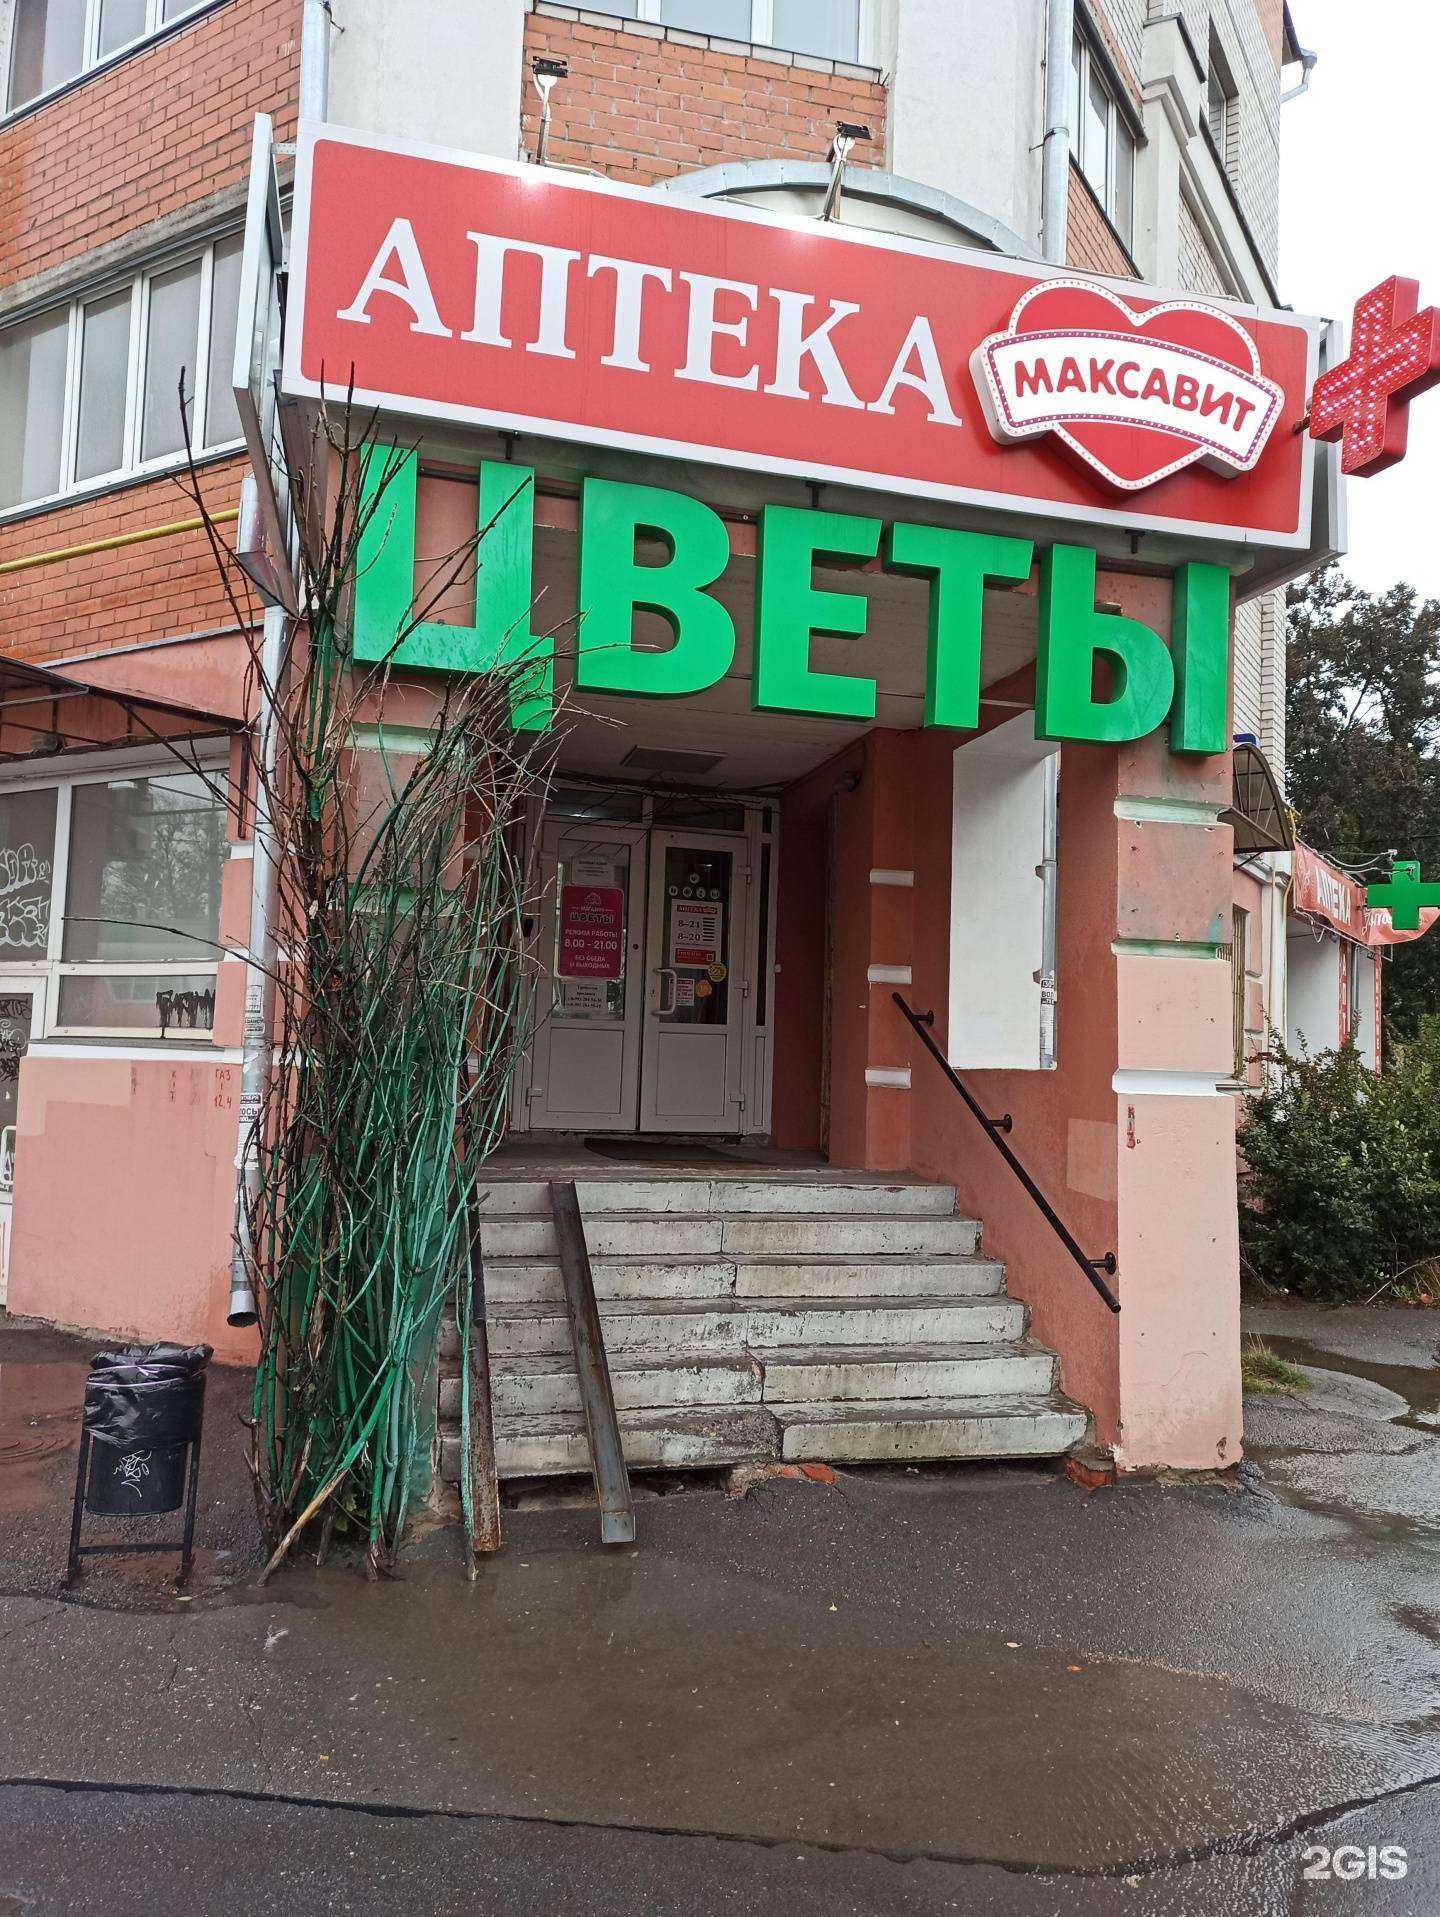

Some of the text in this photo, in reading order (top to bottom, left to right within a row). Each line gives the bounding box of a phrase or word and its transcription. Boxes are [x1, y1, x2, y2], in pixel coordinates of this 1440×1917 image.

[337, 217, 963, 427] АПТЕКА
[1014, 356, 1256, 432] МАКСАВИТ
[352, 442, 1232, 756] ЦВЕТЫ
[570, 912, 614, 923] ЦВЕТЫ
[592, 930, 617, 938] РАБОТЫ
